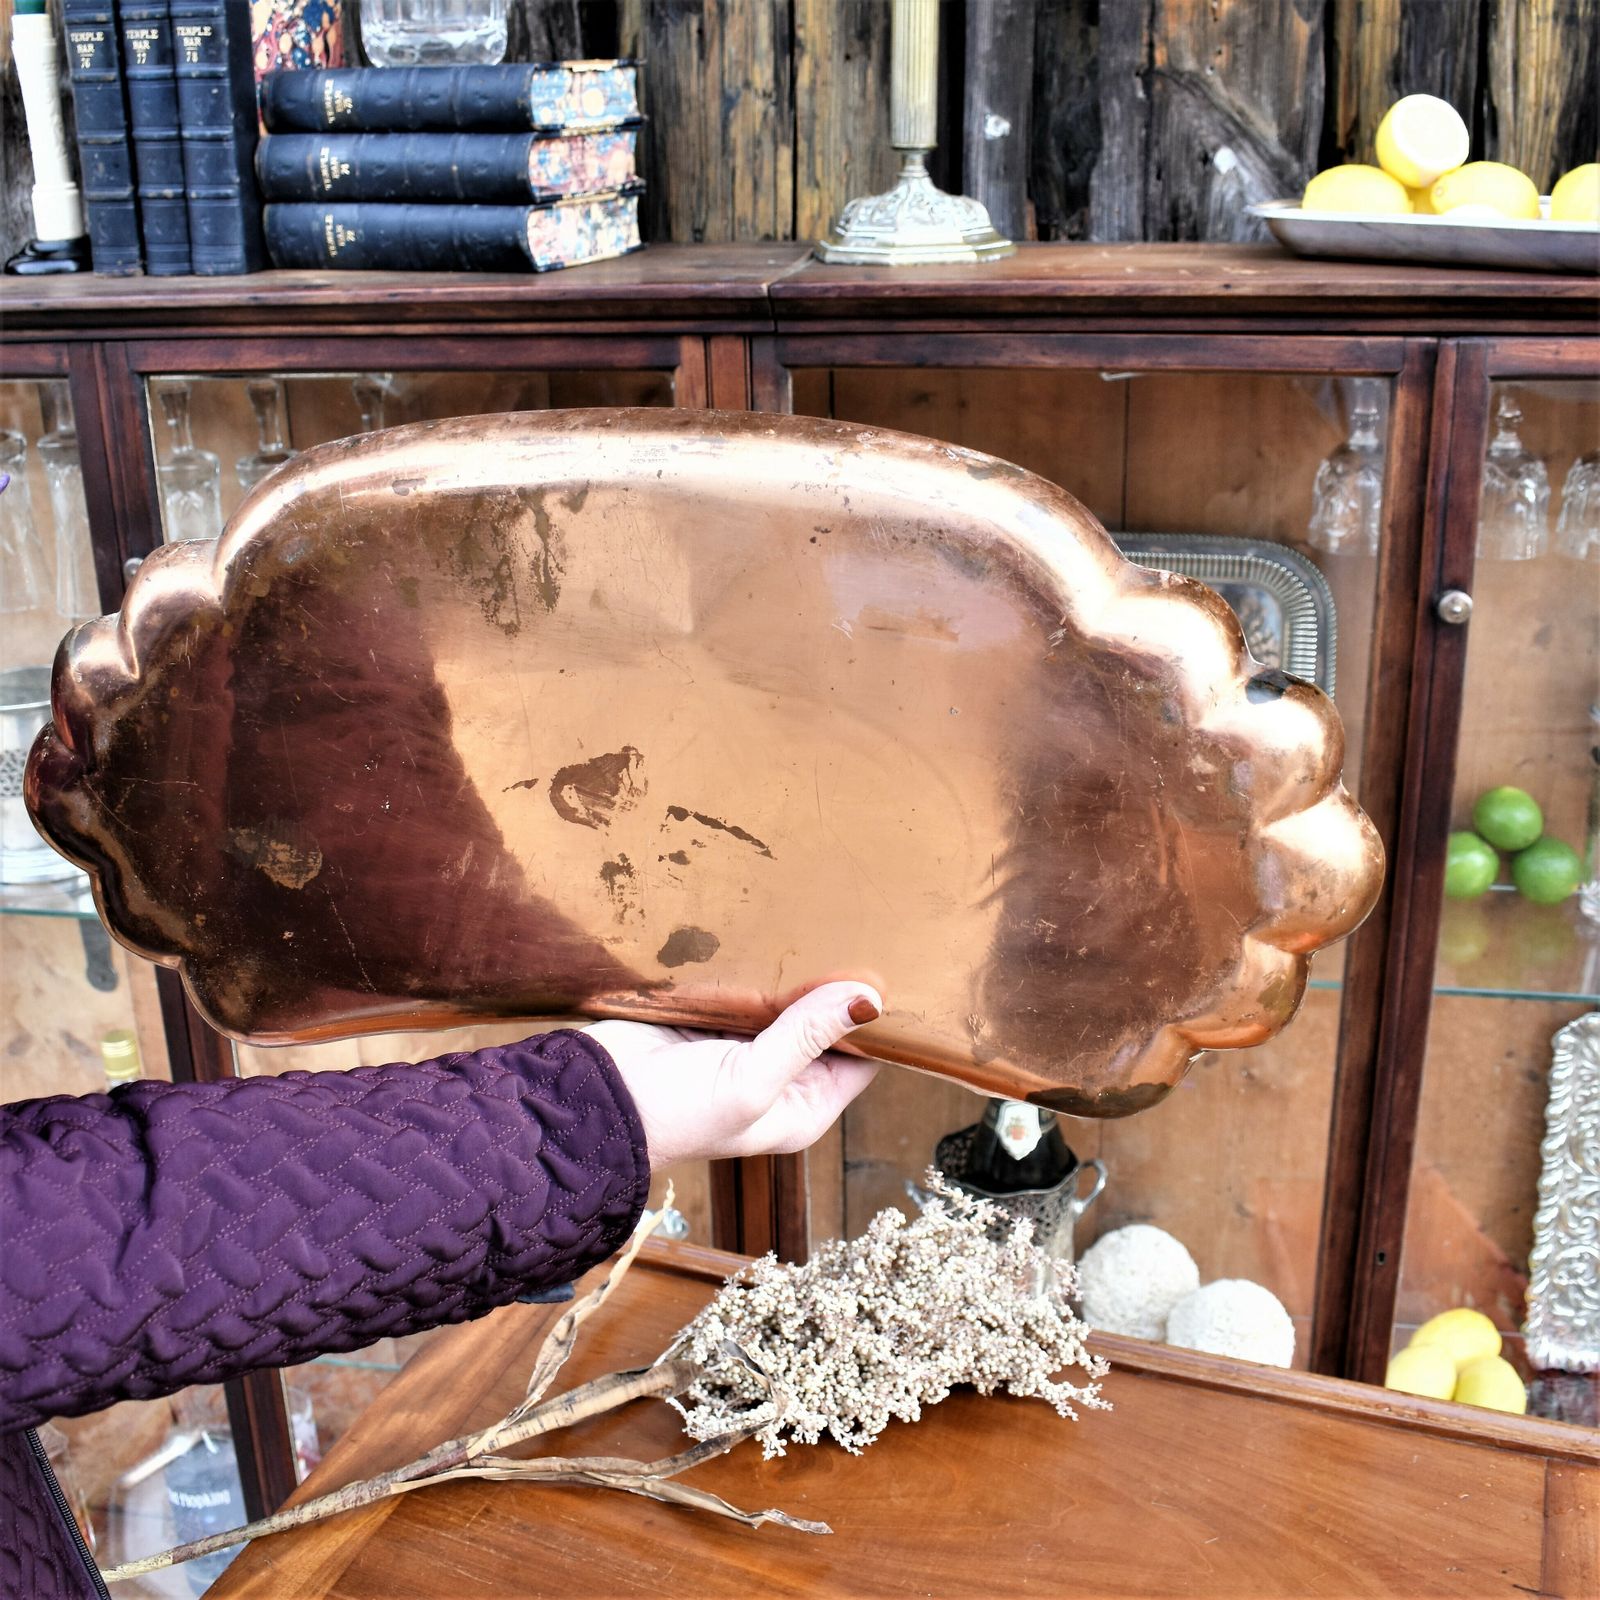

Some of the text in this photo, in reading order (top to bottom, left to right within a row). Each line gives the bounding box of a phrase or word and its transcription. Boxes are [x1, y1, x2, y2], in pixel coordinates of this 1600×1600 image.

[70, 31, 105, 42] TEMPLE
[126, 28, 159, 40] TEMPLE
[176, 25, 212, 37] TEMPLE
[132, 39, 150, 50] BAR
[183, 36, 202, 47] BAR
[77, 43, 95, 54] BAR
[136, 52, 147, 65] 77
[324, 79, 336, 124] TEMPLE
[334, 89, 345, 113] BAR
[320, 147, 332, 191] TEMPLE
[330, 156, 341, 180] BAR
[325, 214, 338, 257] TEMPLE
[335, 224, 346, 247] BAR
